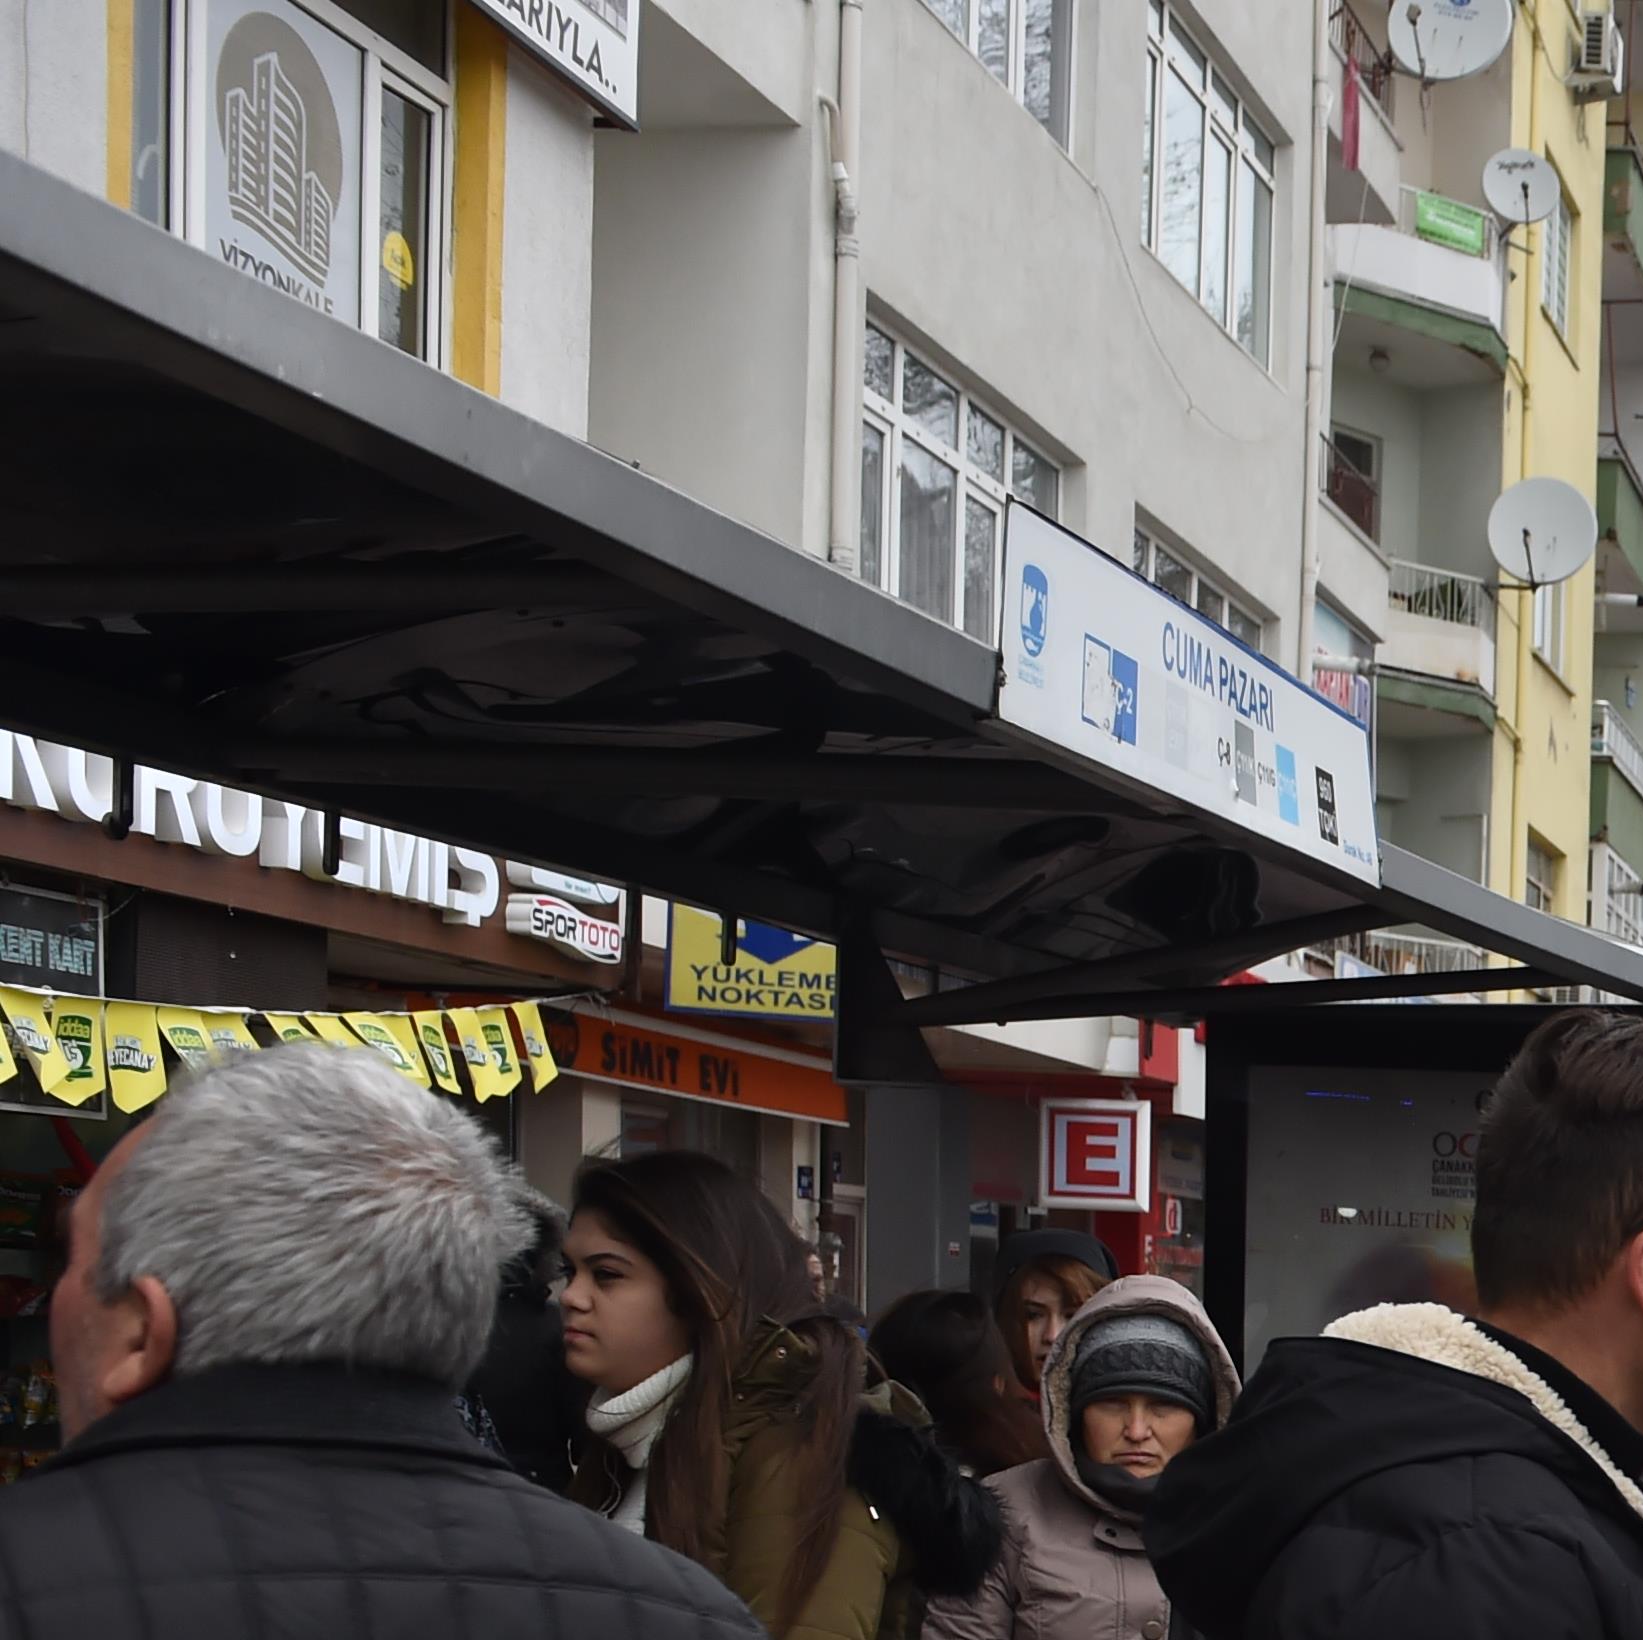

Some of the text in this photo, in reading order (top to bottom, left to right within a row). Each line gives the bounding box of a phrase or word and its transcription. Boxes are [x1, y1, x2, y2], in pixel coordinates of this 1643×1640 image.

[1162, 622, 1215, 697] CUMA
[1219, 656, 1274, 733] PAZARI
[47, 932, 95, 976] KART
[1067, 1122, 1120, 1187] E
[1359, 1207, 1456, 1230] MİLLETİN
